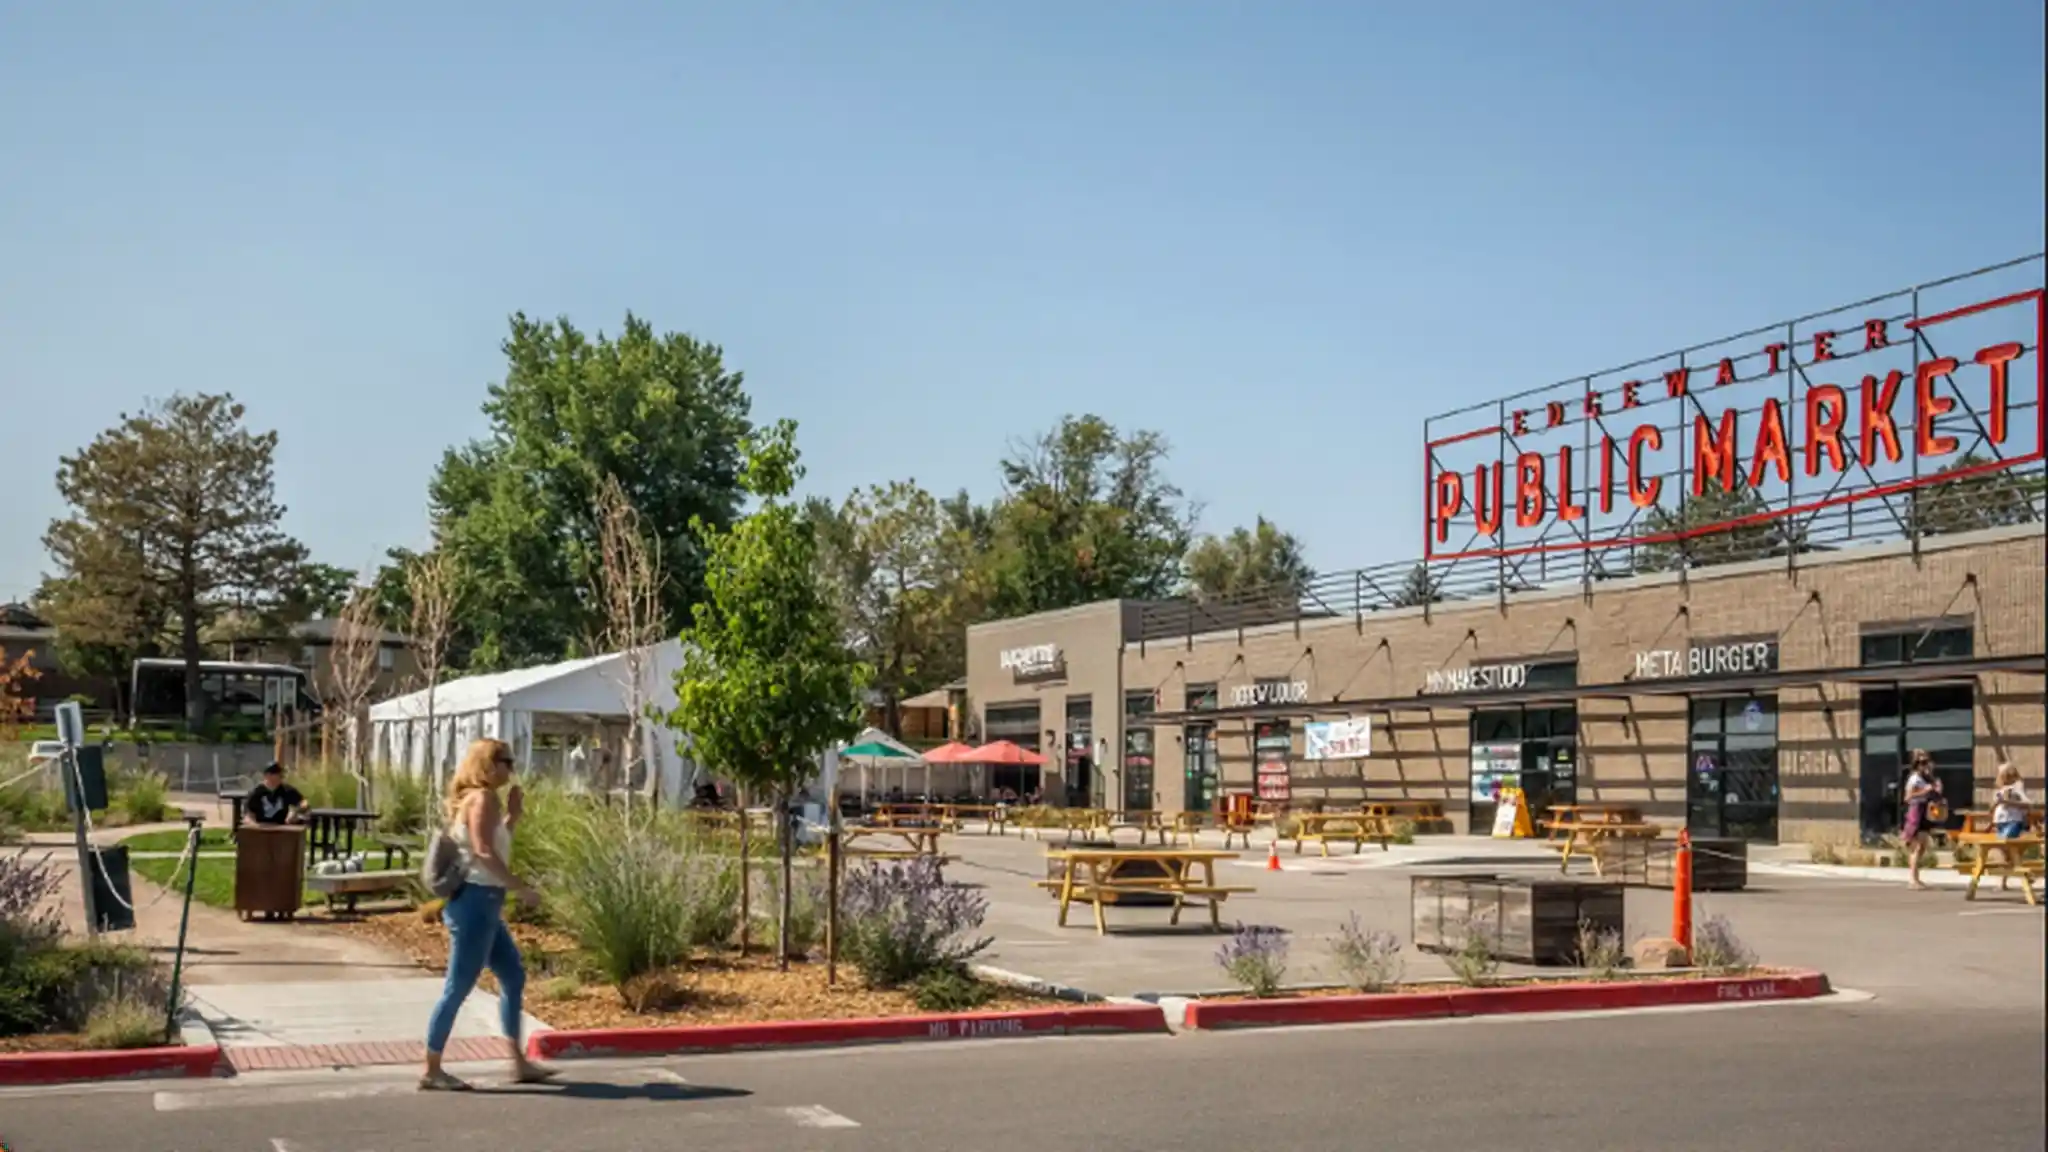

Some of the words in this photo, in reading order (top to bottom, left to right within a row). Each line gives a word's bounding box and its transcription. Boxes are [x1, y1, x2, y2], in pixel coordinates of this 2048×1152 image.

[1512, 319, 1888, 436] EDGEWATER
[1436, 424, 1662, 543] PUBLIC
[1692, 342, 2023, 497] MARKET
[1635, 649, 1682, 678] META
[1688, 642, 1769, 675] BURGER
